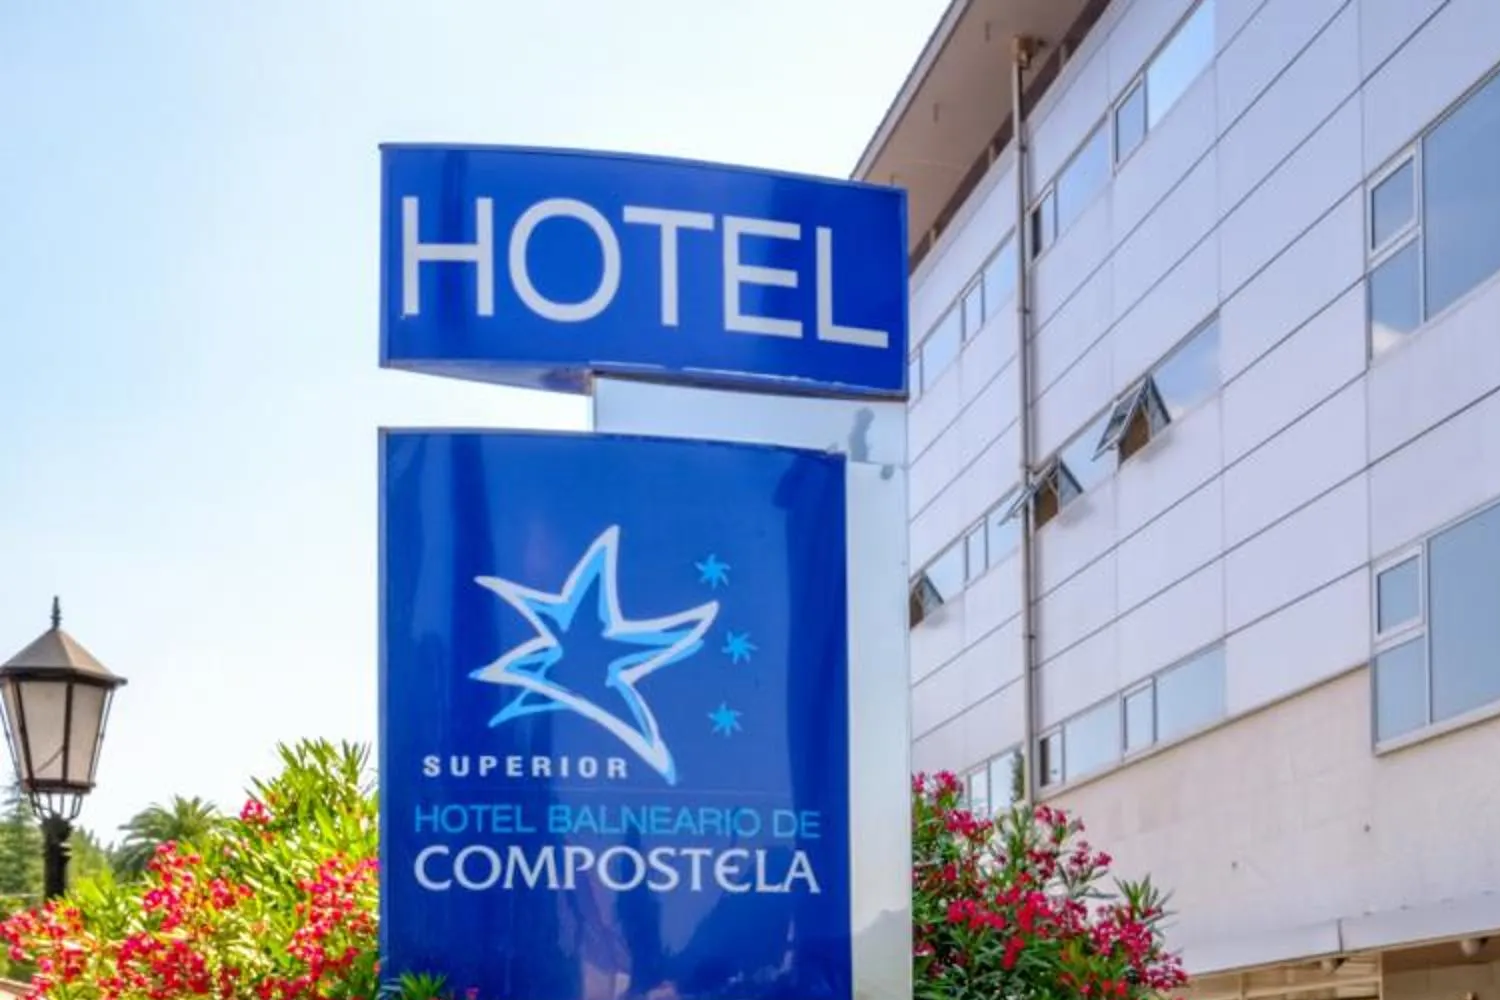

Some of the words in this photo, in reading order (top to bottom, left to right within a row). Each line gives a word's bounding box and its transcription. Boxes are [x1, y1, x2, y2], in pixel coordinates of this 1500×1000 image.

[400, 196, 890, 349] HOTEL
[422, 754, 629, 779] SUPERIOR
[414, 804, 537, 834] HOTEL
[548, 804, 762, 838] BALNEARIO
[772, 809, 822, 838] DE
[413, 844, 822, 893] COMPOSTELA
